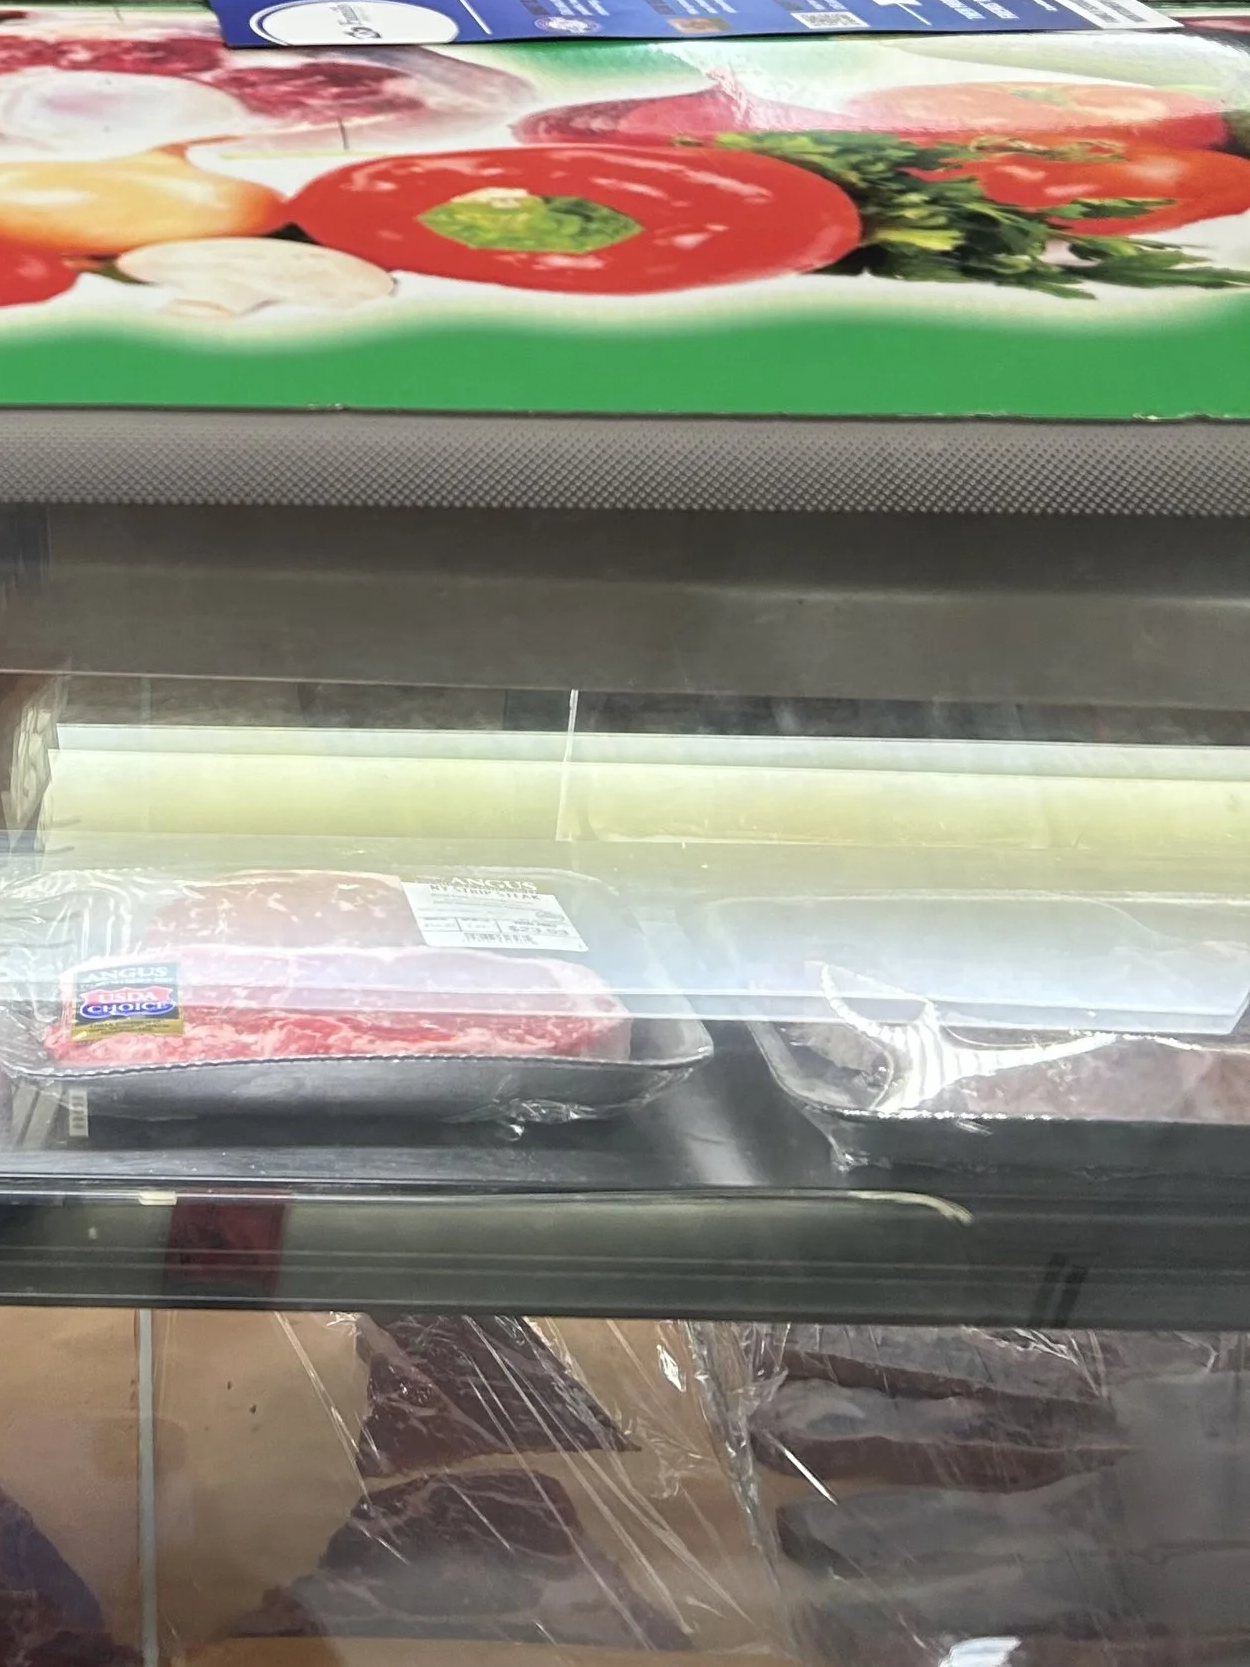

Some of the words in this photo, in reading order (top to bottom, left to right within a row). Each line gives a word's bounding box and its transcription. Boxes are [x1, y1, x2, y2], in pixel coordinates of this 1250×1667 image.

[450, 877, 537, 891] ANGUS
[84, 967, 168, 982] ANGUS
[97, 991, 159, 1003] USDA
[87, 1001, 169, 1014] CHOICE
